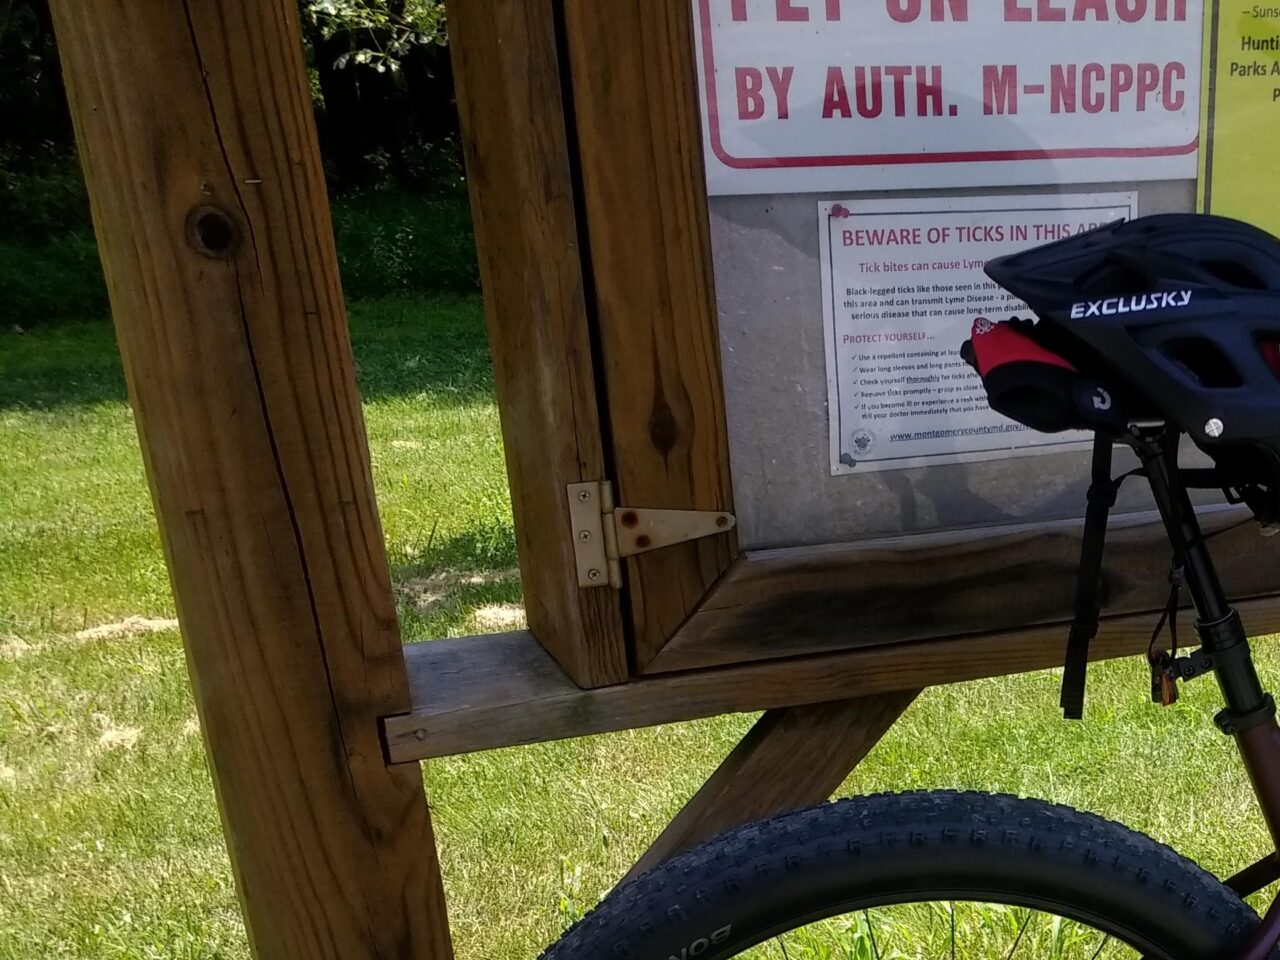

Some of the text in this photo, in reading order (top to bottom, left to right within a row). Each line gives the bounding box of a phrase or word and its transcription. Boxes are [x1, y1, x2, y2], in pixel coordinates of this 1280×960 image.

[1230, 61, 1267, 77] Parks
[735, 61, 1186, 120] BY AUTH. M-NCPPC
[842, 228, 922, 247] BEWARE
[927, 227, 951, 244] OF
[955, 225, 1005, 243] TICKS
[1010, 224, 1027, 241] IN
[1033, 223, 1070, 240] THIS
[859, 262, 880, 273] Tick
[883, 261, 908, 272] bites
[911, 262, 929, 271] can
[932, 261, 960, 270] cause
[846, 285, 896, 297] Black-legged
[898, 285, 915, 294] ticks
[917, 284, 930, 293] like
[932, 284, 953, 292] those
[974, 282, 981, 290] in
[983, 282, 996, 290] this
[879, 299, 894, 307] and
[945, 296, 965, 305] Lyme
[967, 294, 994, 302] Disease
[1070, 290, 1192, 320] EXCLUSKY
[851, 311, 879, 319] serious
[881, 310, 910, 318] disease
[912, 309, 927, 317] that
[966, 306, 1003, 315] long-term
